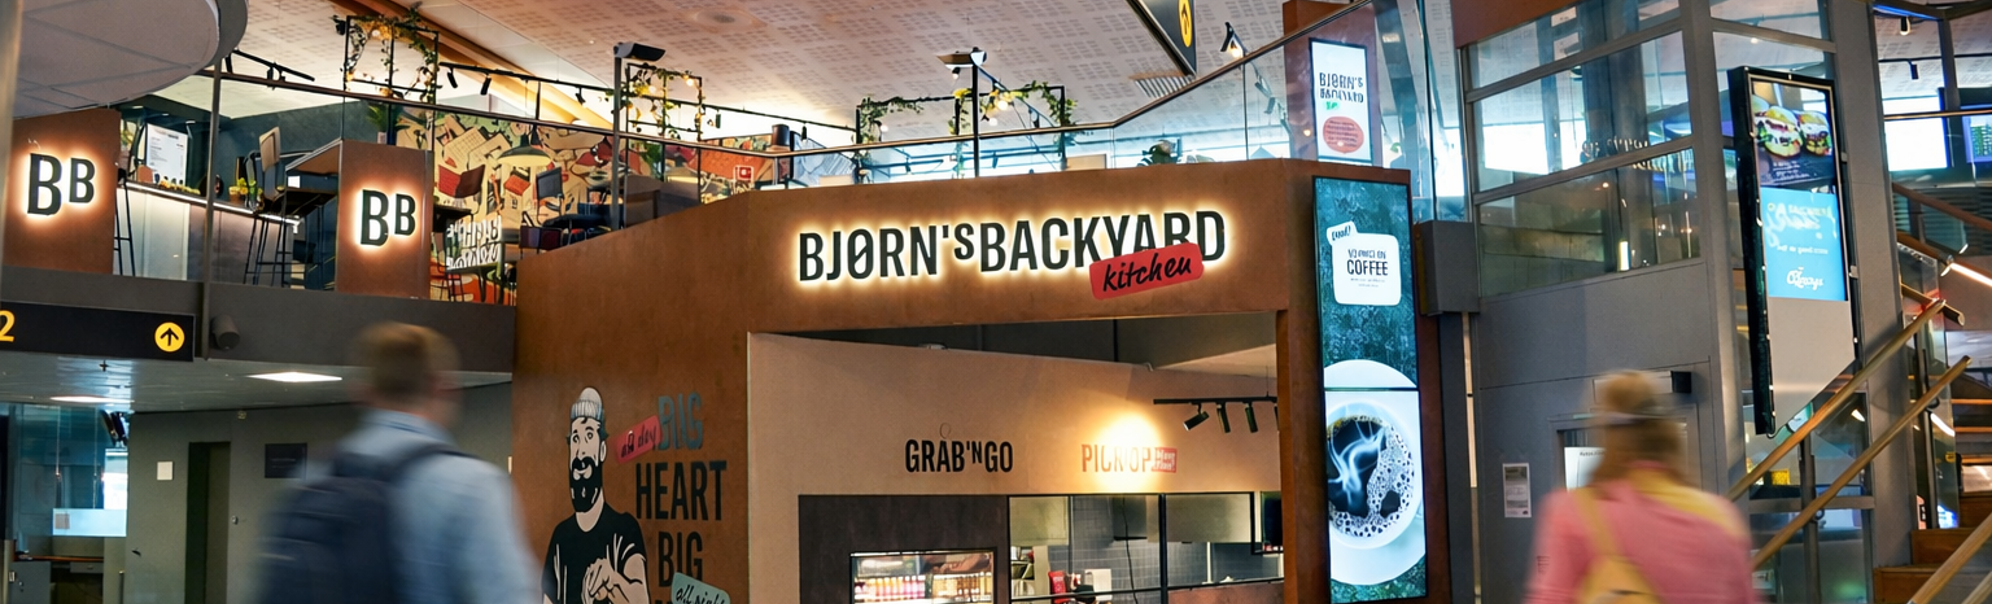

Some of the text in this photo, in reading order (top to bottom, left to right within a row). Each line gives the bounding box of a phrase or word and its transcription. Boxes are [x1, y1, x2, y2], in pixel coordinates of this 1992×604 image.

[27, 153, 95, 215] BB
[360, 189, 416, 247] BB
[1103, 253, 1192, 292] kitchen
[1347, 259, 1388, 276] COFFEE
[657, 392, 703, 450] BIG
[635, 461, 727, 521] HEART
[658, 531, 703, 587] BIG
